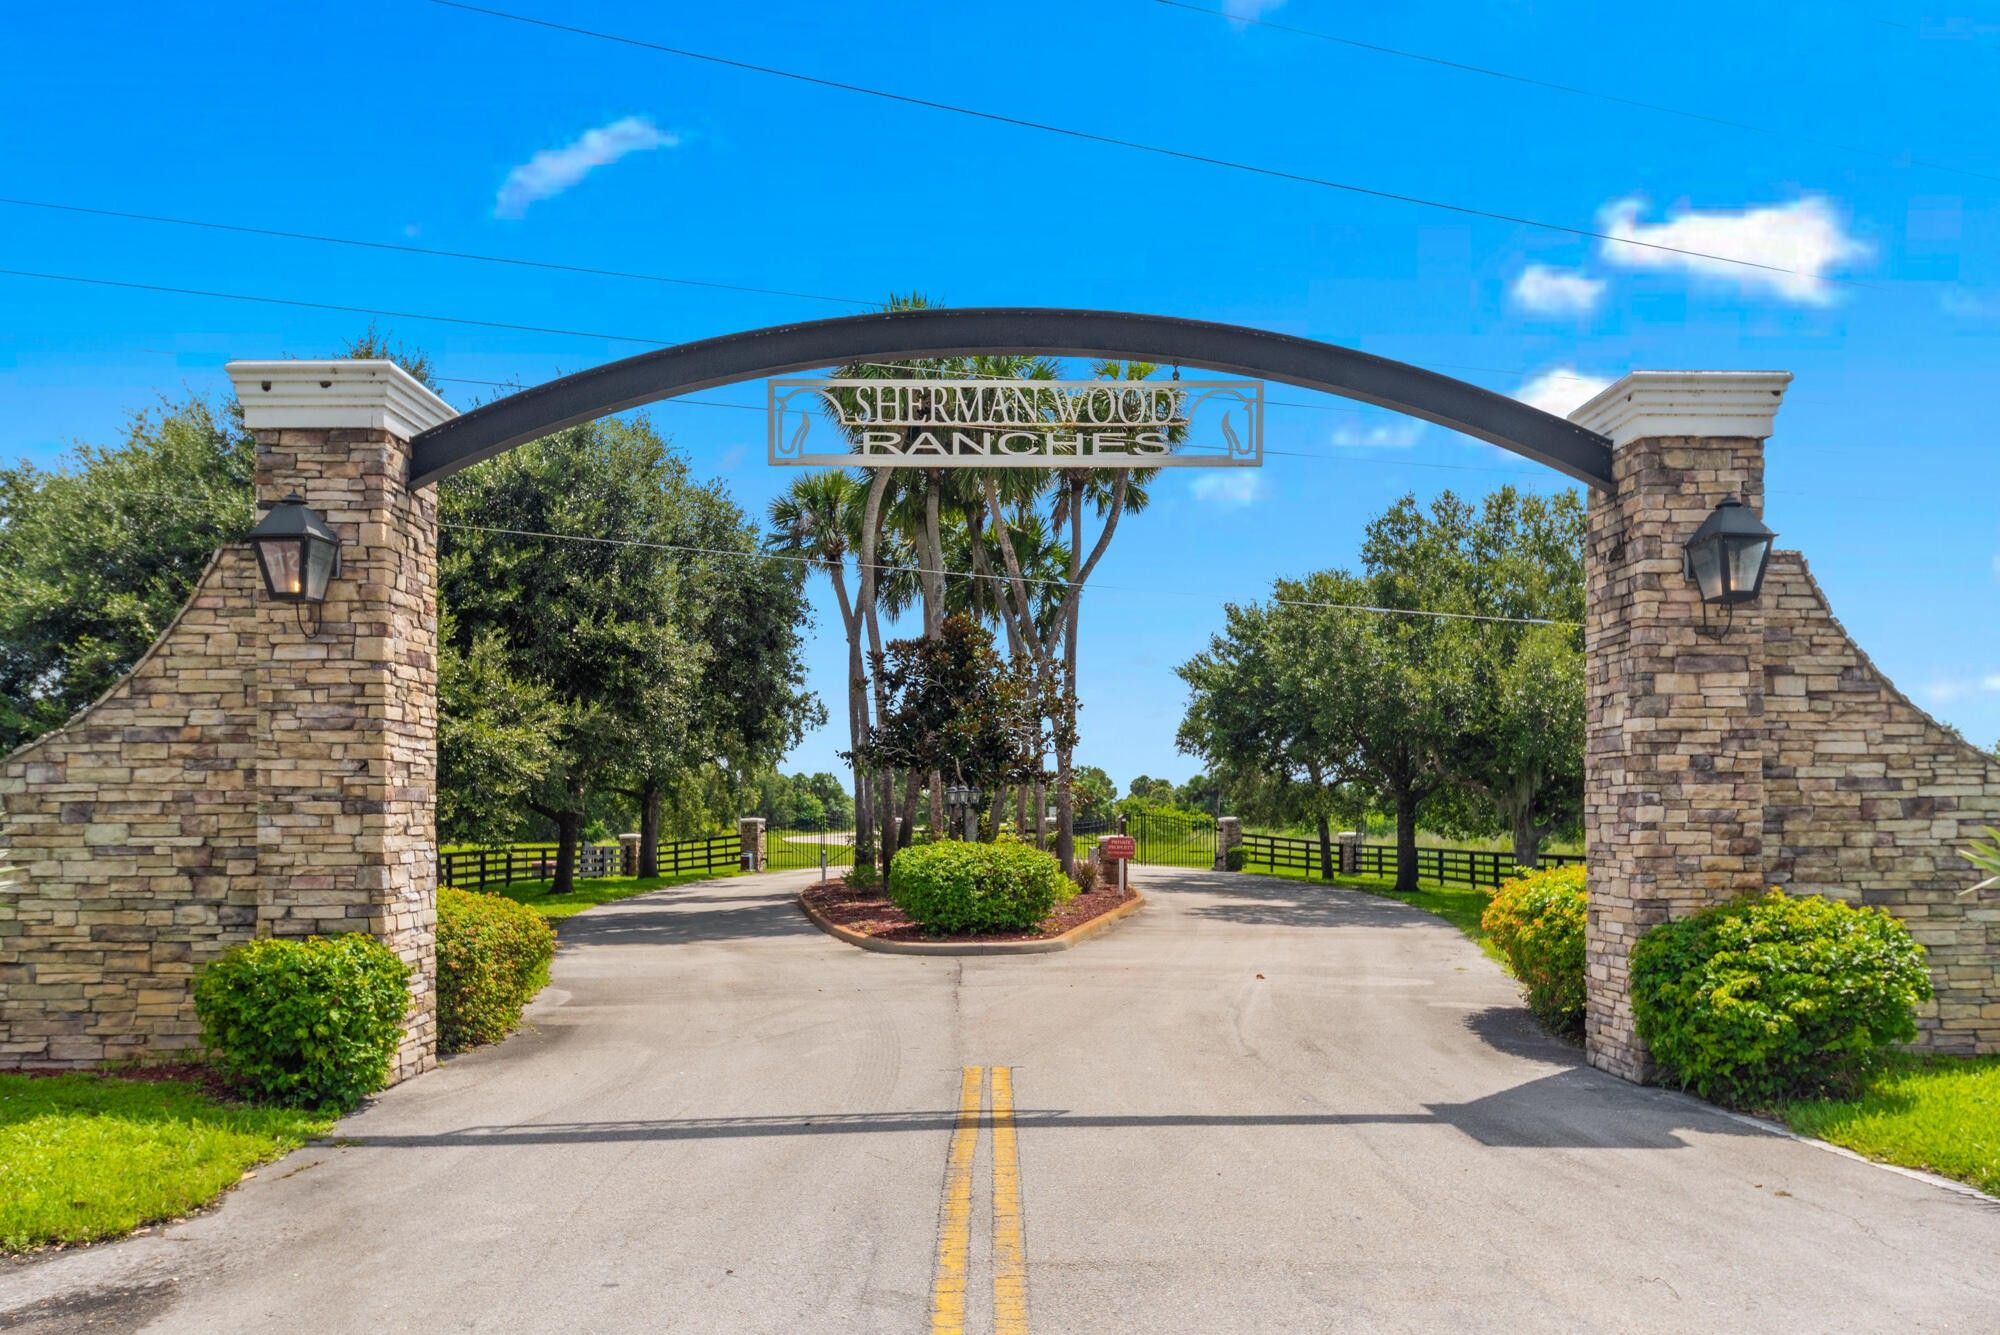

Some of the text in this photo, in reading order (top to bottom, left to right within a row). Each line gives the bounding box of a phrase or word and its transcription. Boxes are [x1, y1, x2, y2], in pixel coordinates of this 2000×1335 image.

[856, 386, 1176, 425] SHERMAN WOOD
[862, 432, 1170, 456] RANCHES
